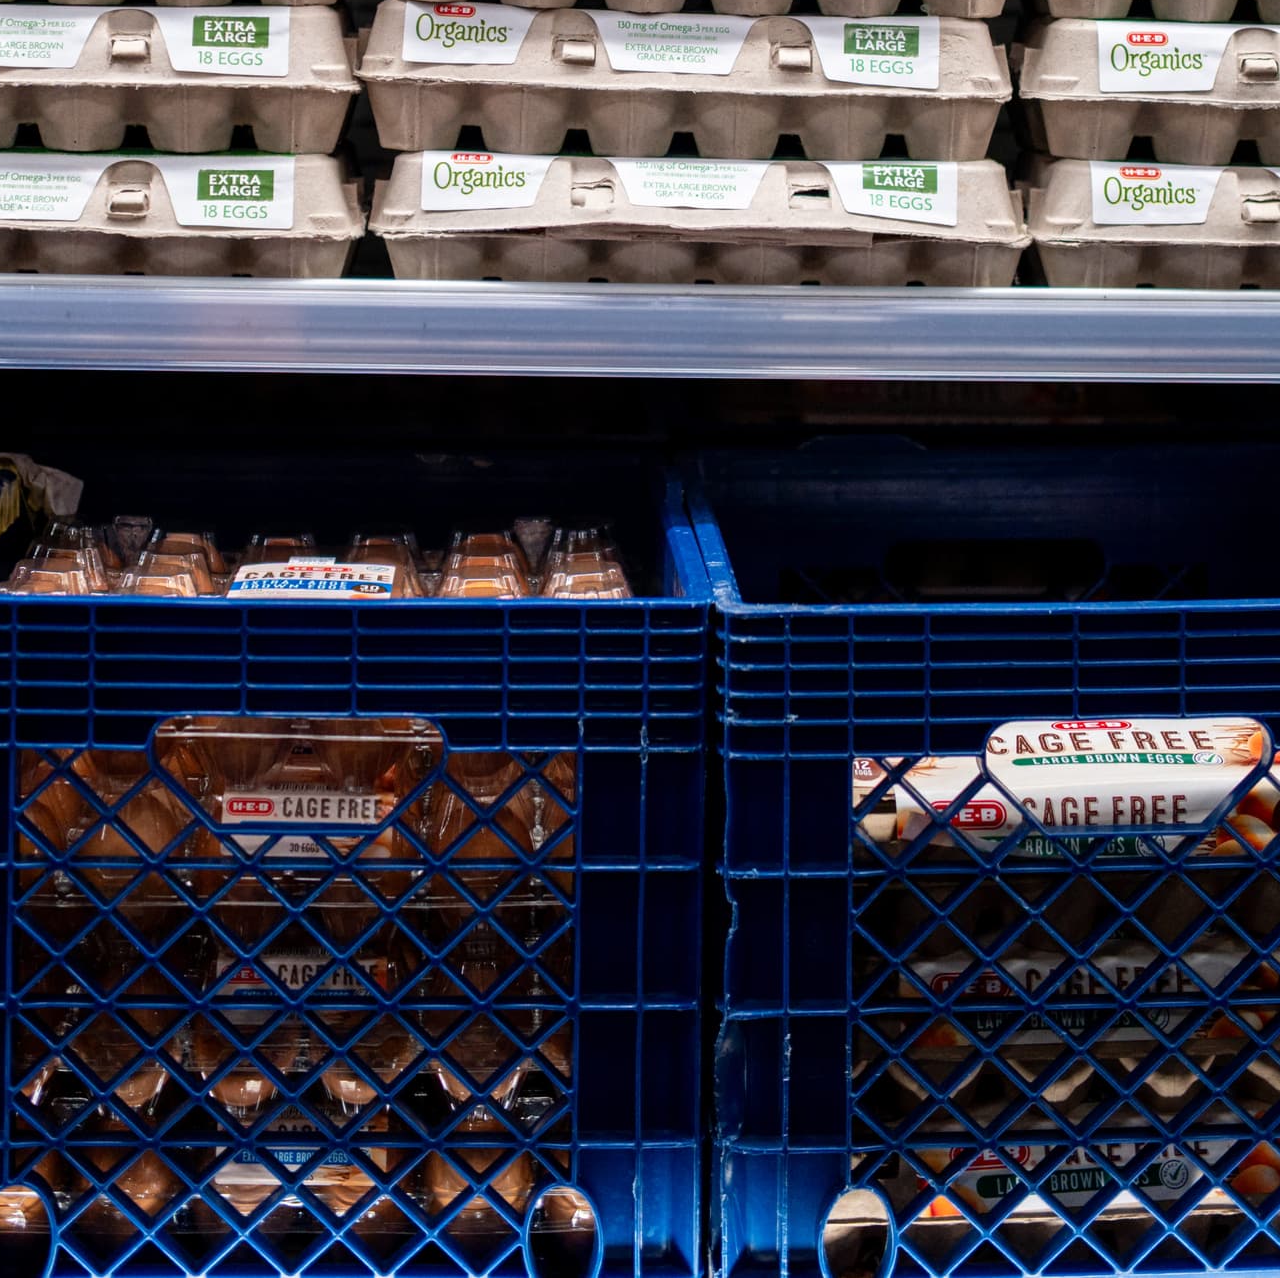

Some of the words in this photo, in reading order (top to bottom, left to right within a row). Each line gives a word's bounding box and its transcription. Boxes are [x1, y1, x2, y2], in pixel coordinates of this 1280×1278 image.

[6, 18, 47, 29] Omega-3
[203, 21, 256, 33] EXTRA
[416, 13, 508, 47] Organics
[204, 31, 256, 44] LARGE
[854, 28, 906, 41] EXTRA
[0, 41, 27, 50] LARGE
[29, 42, 64, 50] BROWN
[855, 39, 906, 52] LARGE
[28, 51, 52, 59] EGGS
[198, 52, 213, 65] 18
[218, 52, 263, 66] EGGS
[1111, 43, 1202, 76] Organics
[850, 59, 864, 72] 18
[870, 59, 914, 74] EGGS
[433, 161, 526, 196] Organics
[1103, 176, 1195, 210] Organics
[869, 195, 884, 208] 18
[244, 571, 316, 580] CAGE
[323, 573, 392, 582] FREE
[987, 732, 1094, 755] CAGE
[1107, 730, 1215, 751] FREE
[1033, 755, 1080, 765] LARGE
[1086, 753, 1141, 764] BROWN
[1146, 753, 1185, 764] EGGS
[283, 797, 330, 819] CAGE
[337, 798, 382, 819] FREE
[1022, 796, 1098, 826] CAGE
[1112, 795, 1187, 825] FREE
[289, 843, 300, 853] 30
[301, 843, 320, 853] EGGS
[1051, 1172, 1105, 1188] BROWN
